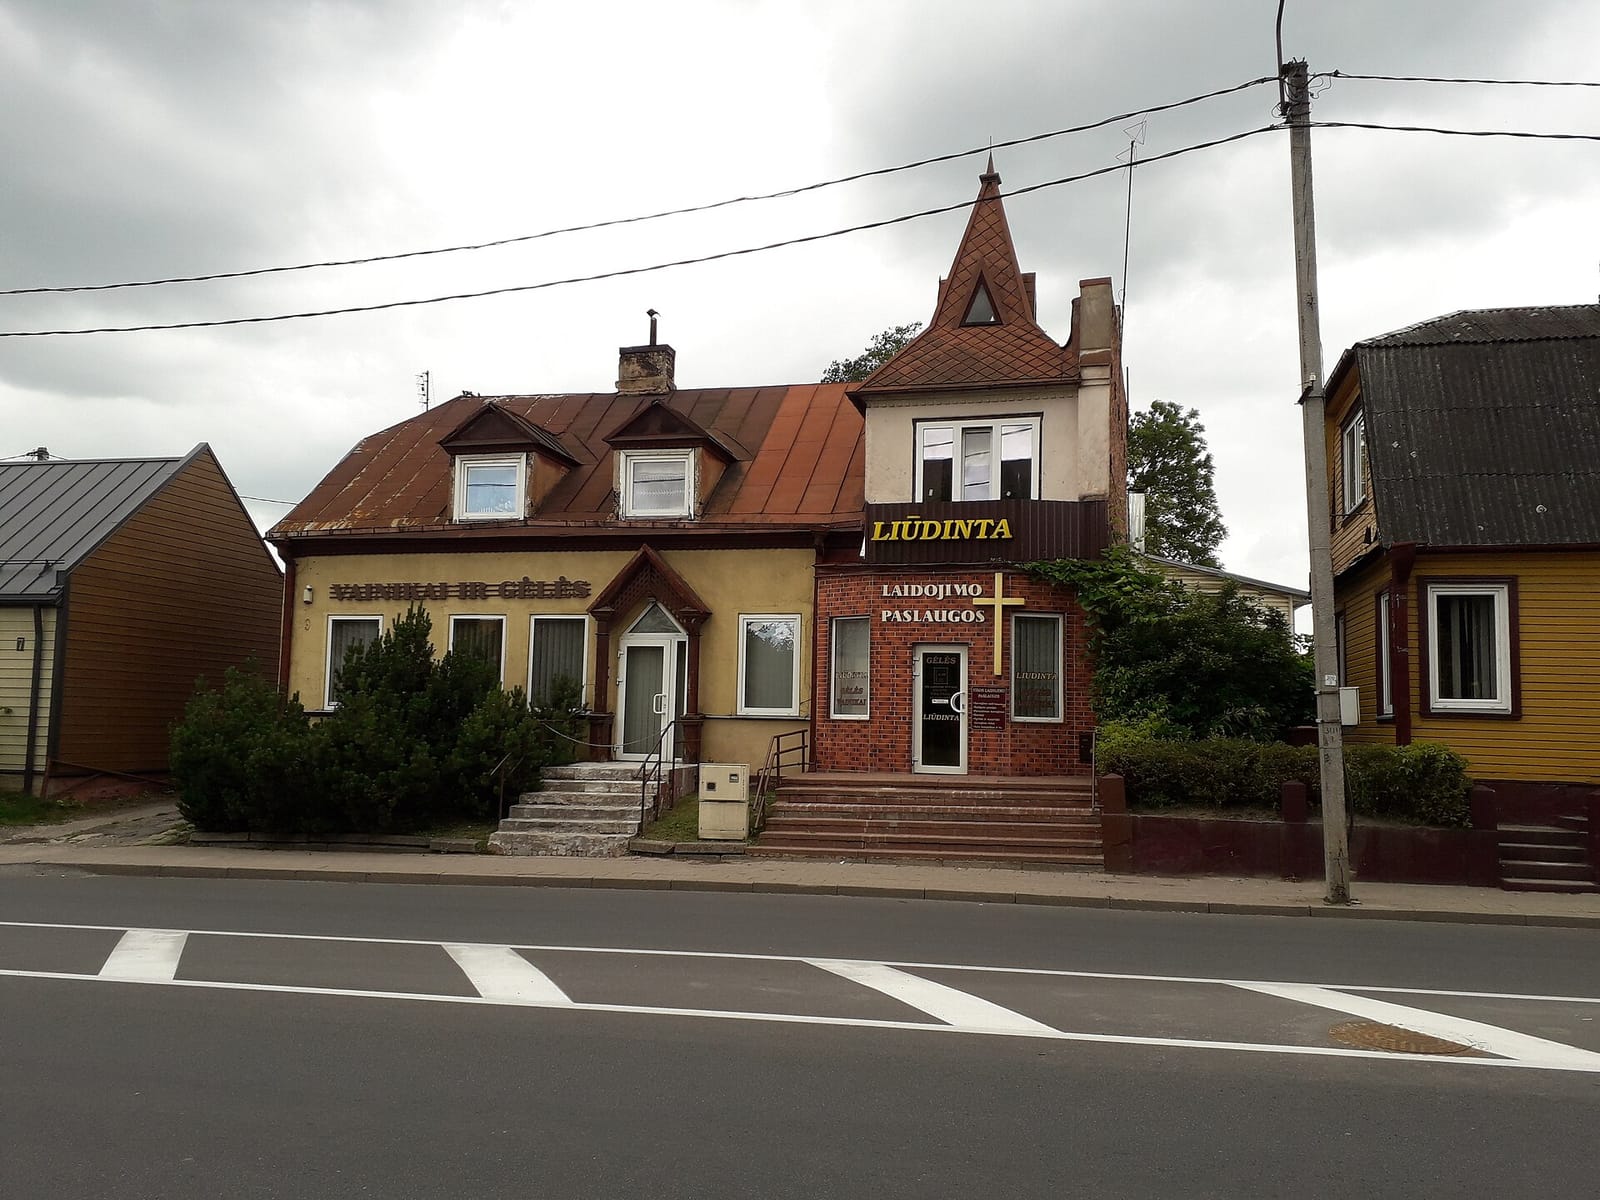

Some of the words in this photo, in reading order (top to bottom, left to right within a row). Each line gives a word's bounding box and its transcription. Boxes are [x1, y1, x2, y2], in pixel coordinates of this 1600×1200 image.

[870, 515, 1013, 541] LIŪDINTA
[334, 582, 449, 601] VAINIKAI
[457, 582, 489, 600] IR
[498, 575, 590, 599] GĖLĖS
[882, 584, 983, 600] LAIDOJIMO
[881, 609, 985, 623] PASLAUGOS
[17, 639, 24, 650] 7
[922, 712, 960, 721] LIŪDINTA
